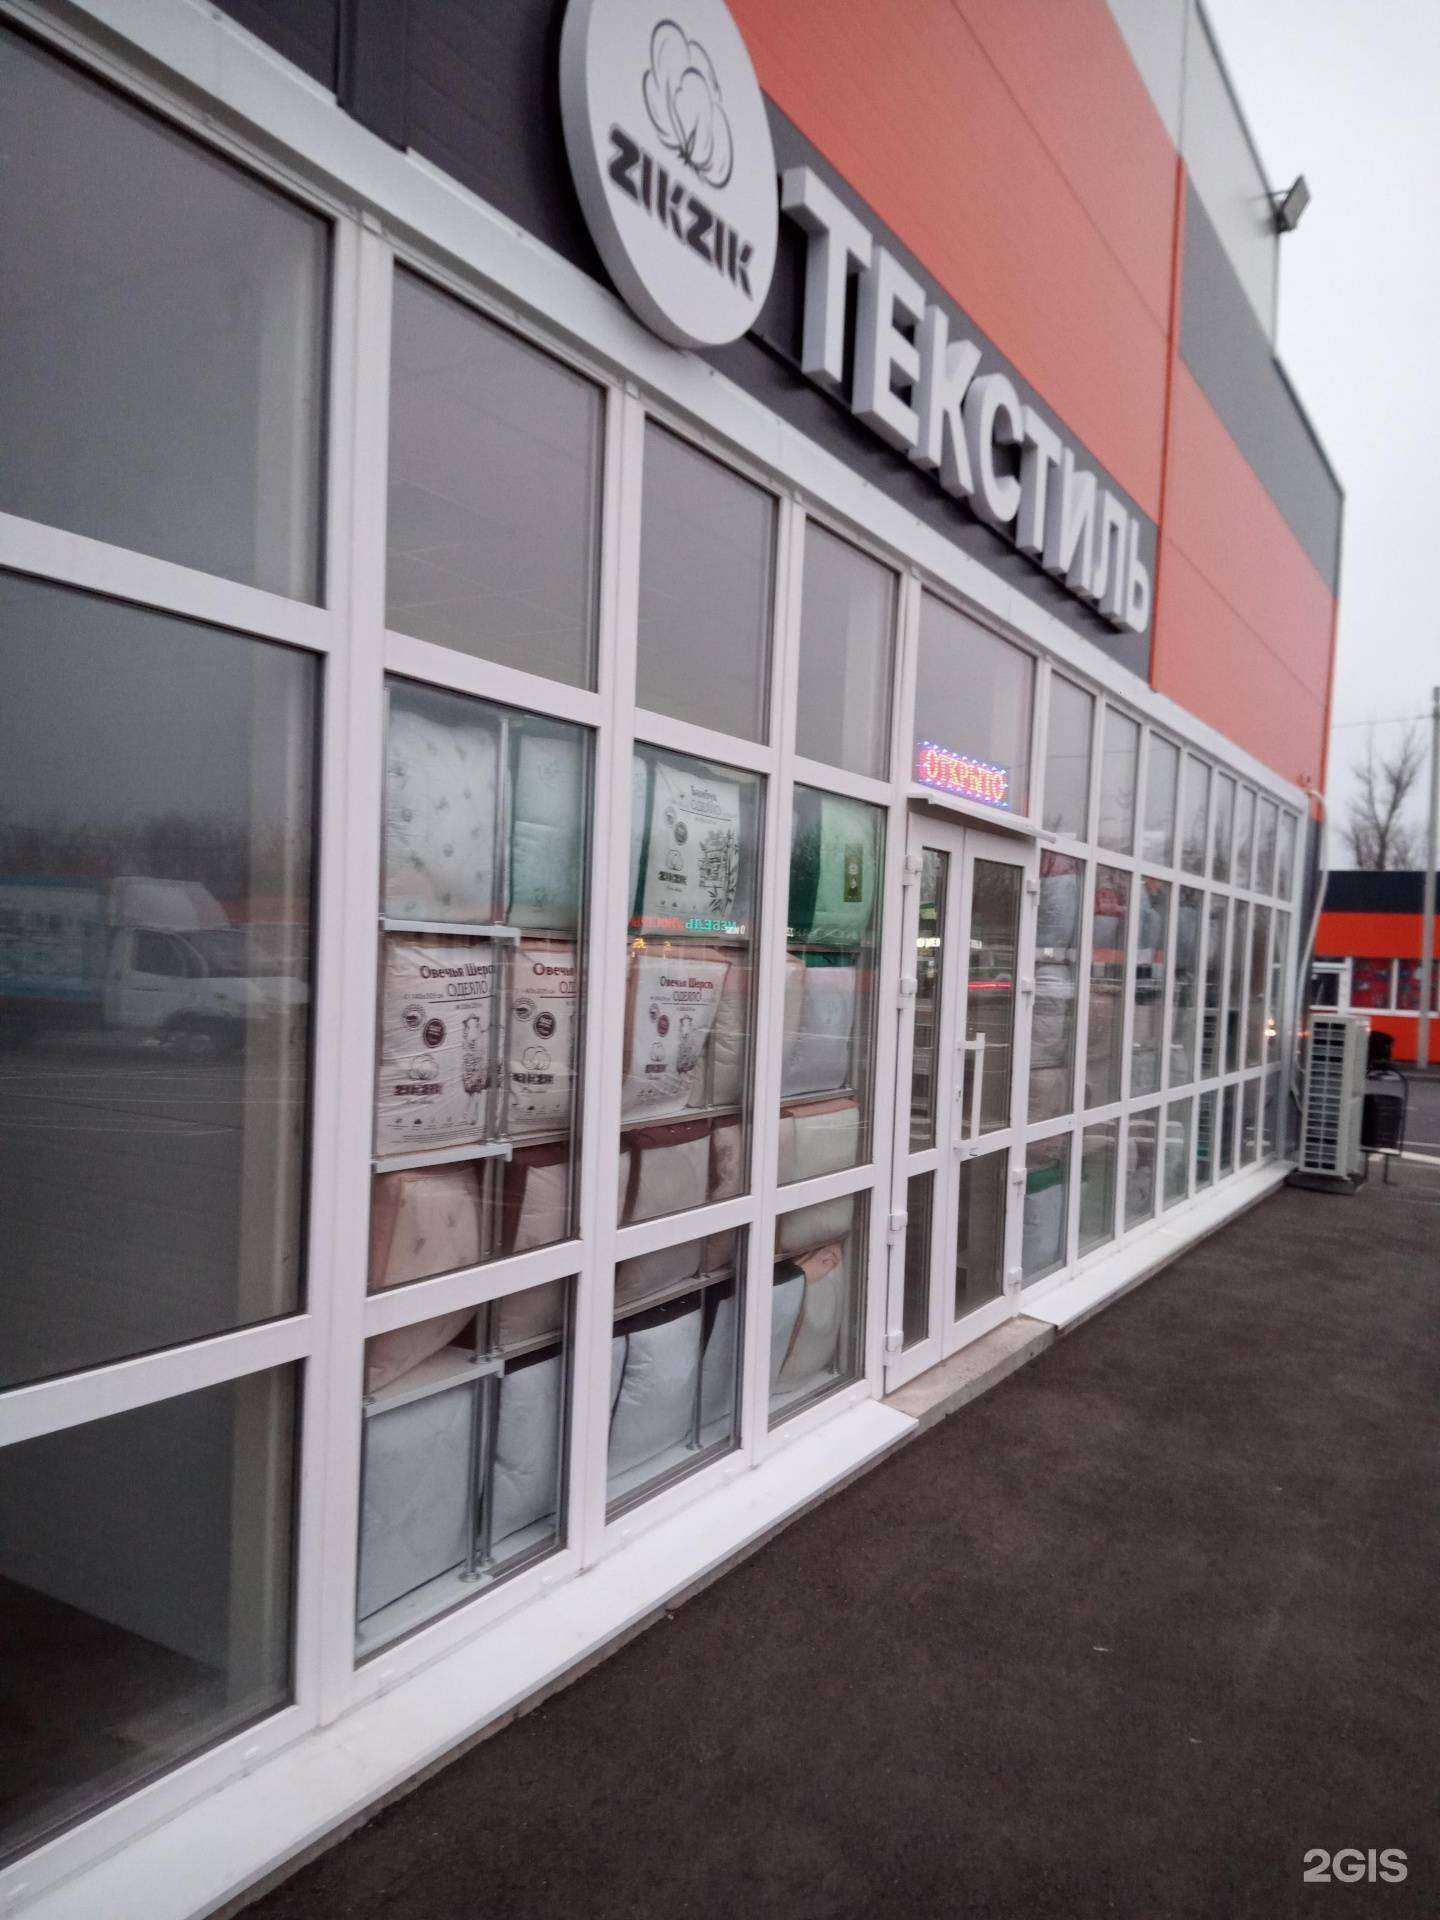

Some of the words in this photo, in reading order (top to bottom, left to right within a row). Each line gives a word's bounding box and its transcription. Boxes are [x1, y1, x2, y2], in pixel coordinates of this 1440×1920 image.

[606, 124, 753, 302] ZIKZIK
[783, 166, 1150, 633] ТЕКСТИЛЬ
[420, 965, 464, 979] Овечья
[466, 963, 496, 979] Шерс
[447, 980, 489, 997] ОДЕЯЛО
